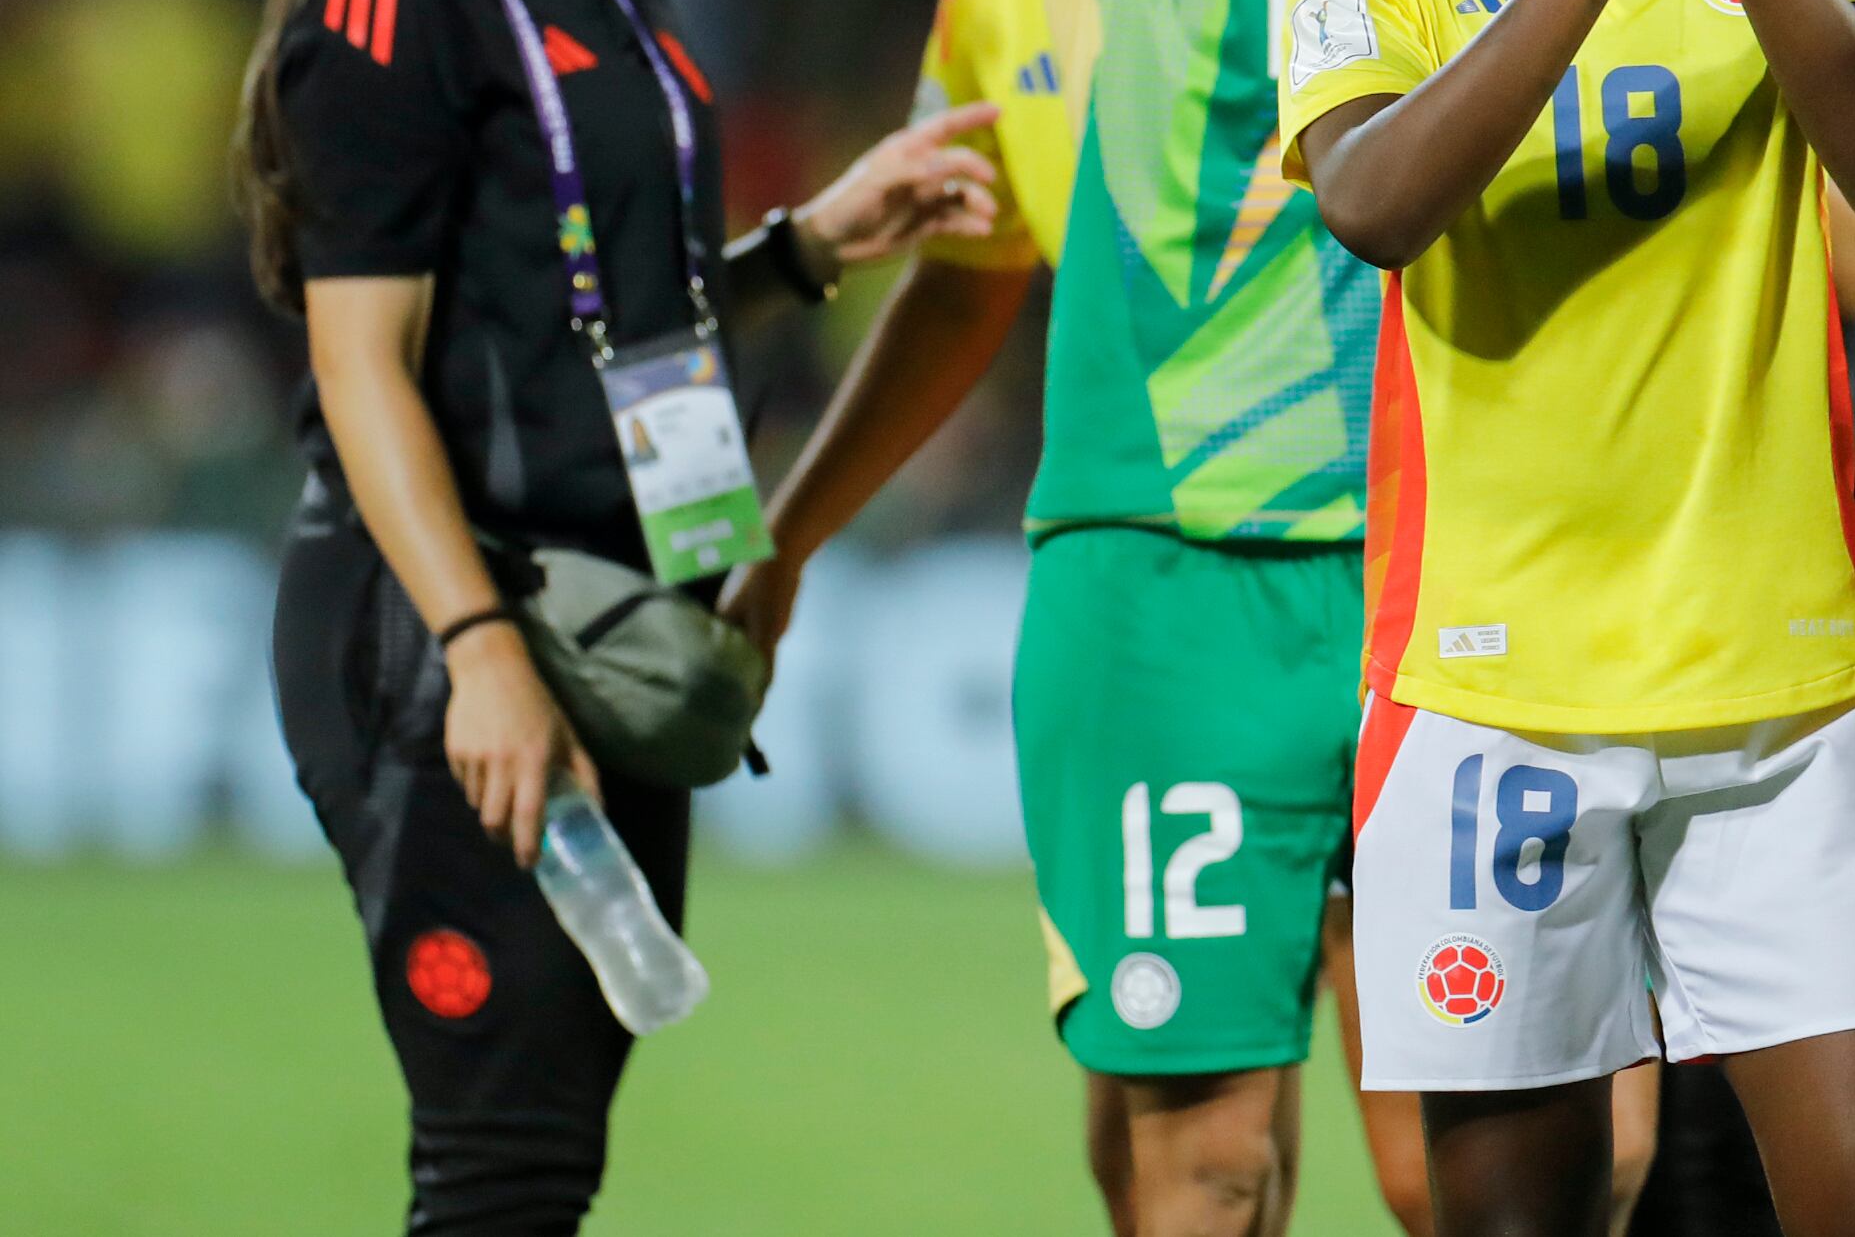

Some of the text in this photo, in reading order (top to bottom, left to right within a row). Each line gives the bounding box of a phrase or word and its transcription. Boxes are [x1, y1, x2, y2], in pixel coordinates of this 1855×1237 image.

[1552, 64, 1687, 220] 18
[1122, 781, 1246, 939] 12
[1450, 753, 1578, 911] 18
